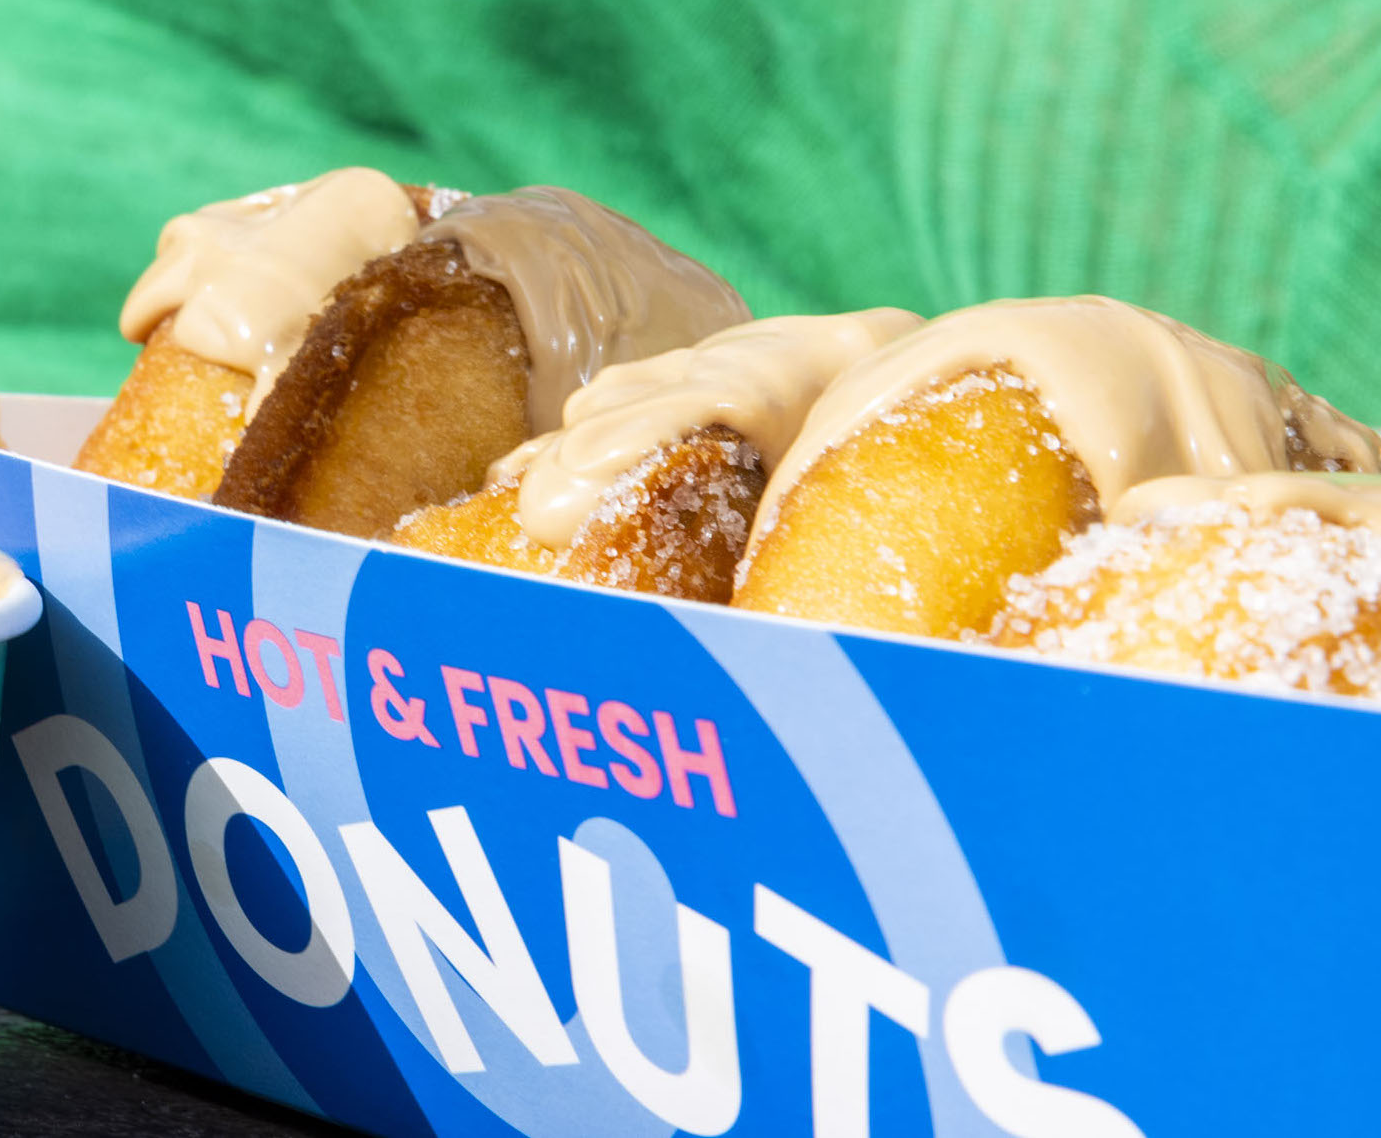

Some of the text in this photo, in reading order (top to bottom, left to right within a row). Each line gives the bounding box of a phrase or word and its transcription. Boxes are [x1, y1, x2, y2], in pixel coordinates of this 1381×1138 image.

[185, 600, 738, 818] HOT & FRESH
[11, 714, 1148, 1138] DONUTS
